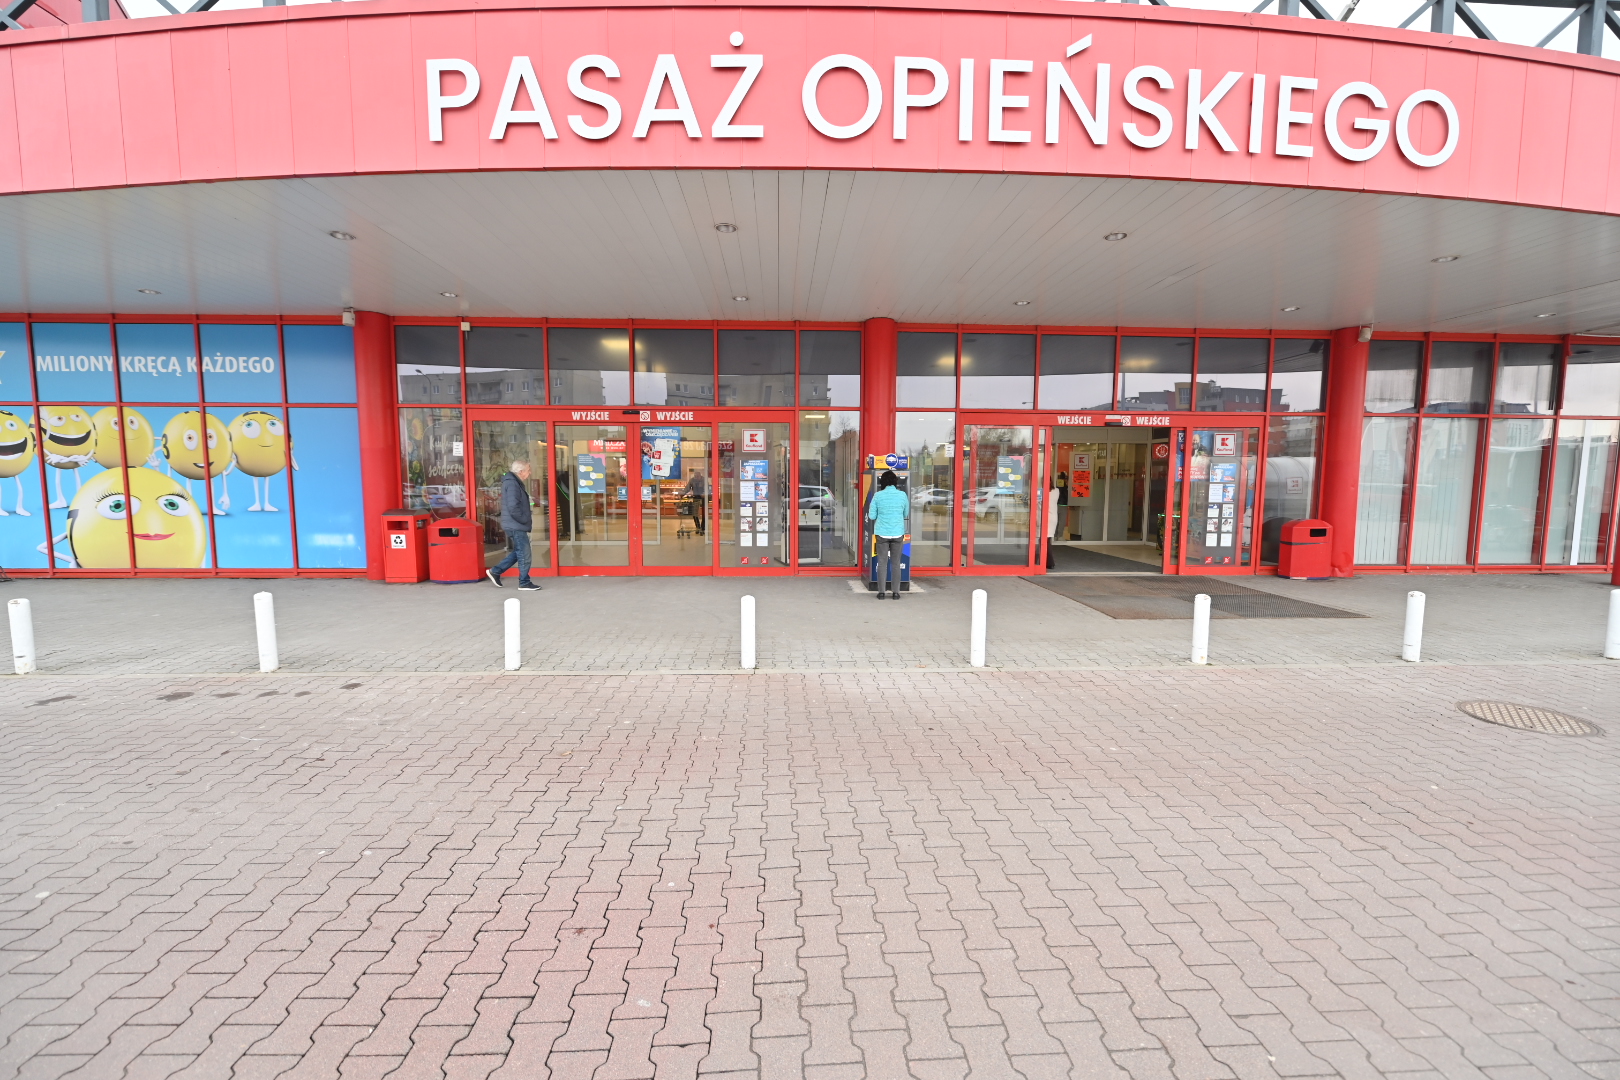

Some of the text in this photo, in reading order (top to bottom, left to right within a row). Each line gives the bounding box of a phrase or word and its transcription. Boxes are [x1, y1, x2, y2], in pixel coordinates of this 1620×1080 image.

[426, 31, 1459, 168] PASAŻ OPIEŃSKIEGO
[36, 352, 275, 376] MILIONY KRĘCĄ KAŻDEGO
[572, 410, 610, 421] WYJŚCIE
[656, 410, 694, 421] WYJŚCIE
[1057, 414, 1092, 425] WEJŚCIE
[1136, 414, 1170, 426] WEJŚCIE
